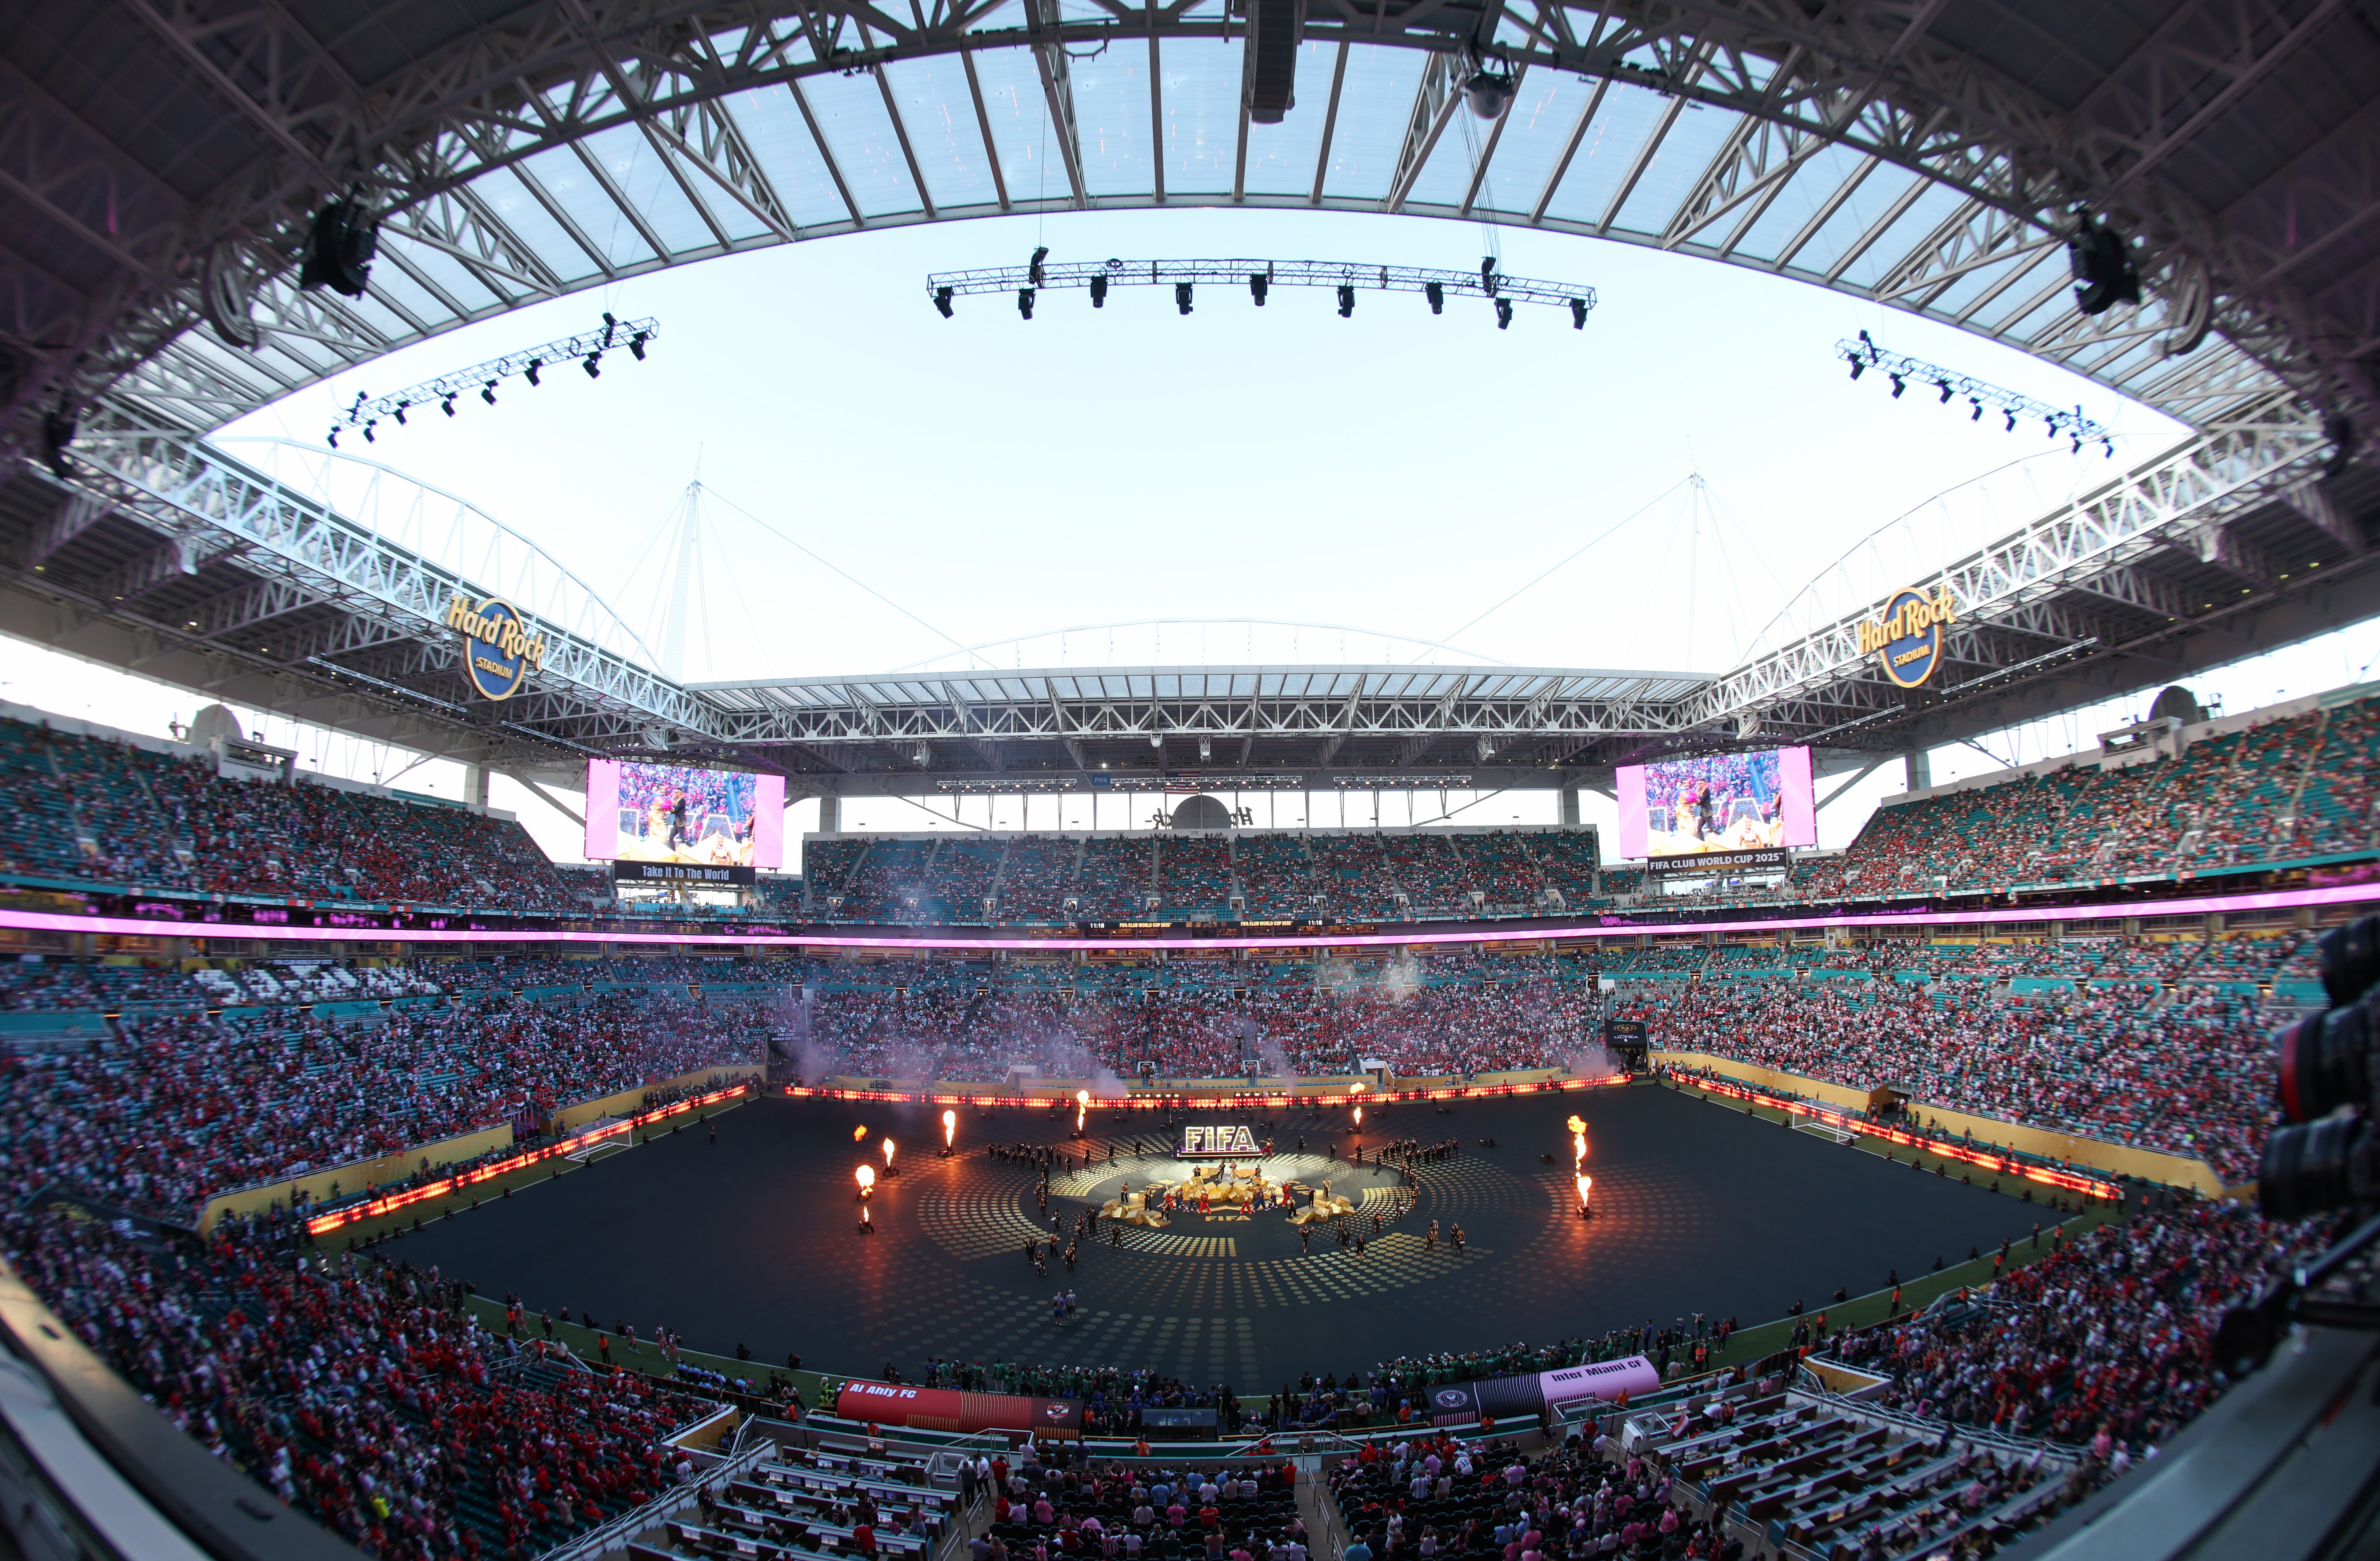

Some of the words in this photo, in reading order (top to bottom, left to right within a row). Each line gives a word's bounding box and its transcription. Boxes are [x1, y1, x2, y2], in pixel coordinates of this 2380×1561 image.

[1859, 605, 1905, 654] Hard
[1904, 585, 1958, 638] Rock
[447, 594, 503, 644] Hard
[497, 618, 545, 671] Rock
[1893, 644, 1931, 667] STADIUM
[475, 656, 512, 679] STADIUM
[642, 865, 663, 877] Take
[665, 867, 672, 878] It
[674, 867, 684, 878] To
[686, 868, 702, 879] The
[704, 869, 729, 880] World
[1650, 861, 1670, 870] FIFA
[1671, 859, 1695, 868] CLUB
[1697, 856, 1732, 866] WORLD
[1733, 855, 1753, 863] CUP
[1186, 1126, 1257, 1152] FIFA
[1551, 1371, 1583, 1382] Inter
[1585, 1363, 1627, 1376] Miami
[1627, 1360, 1642, 1368] CF
[849, 1384, 865, 1392] Al
[866, 1386, 898, 1397] Ahly
[899, 1389, 917, 1398] FC
[832, 1515, 840, 1524] 10
